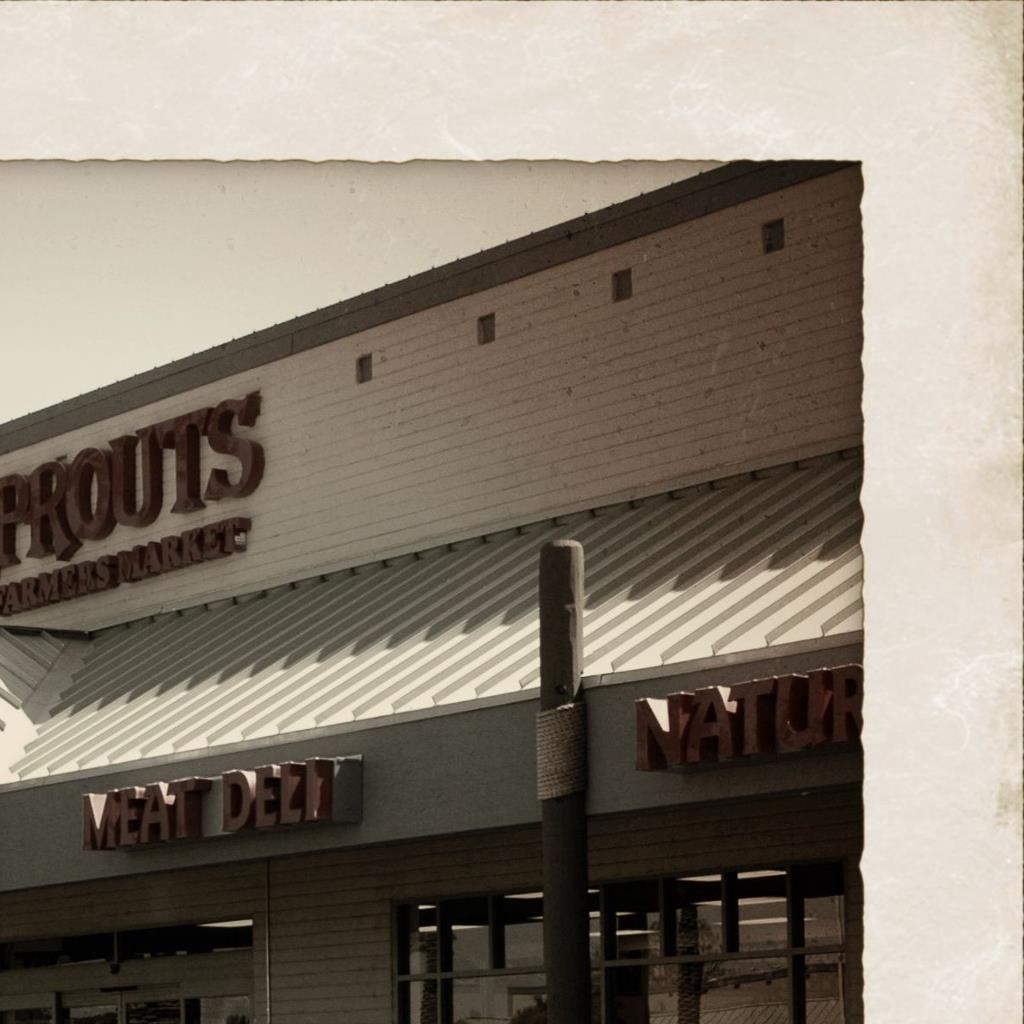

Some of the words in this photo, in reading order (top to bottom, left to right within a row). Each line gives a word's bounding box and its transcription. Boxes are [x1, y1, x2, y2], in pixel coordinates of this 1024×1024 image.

[117, 516, 252, 584] MARKET
[635, 663, 864, 771] NATUR
[82, 777, 213, 850] MEAT
[222, 756, 336, 833] DELI
